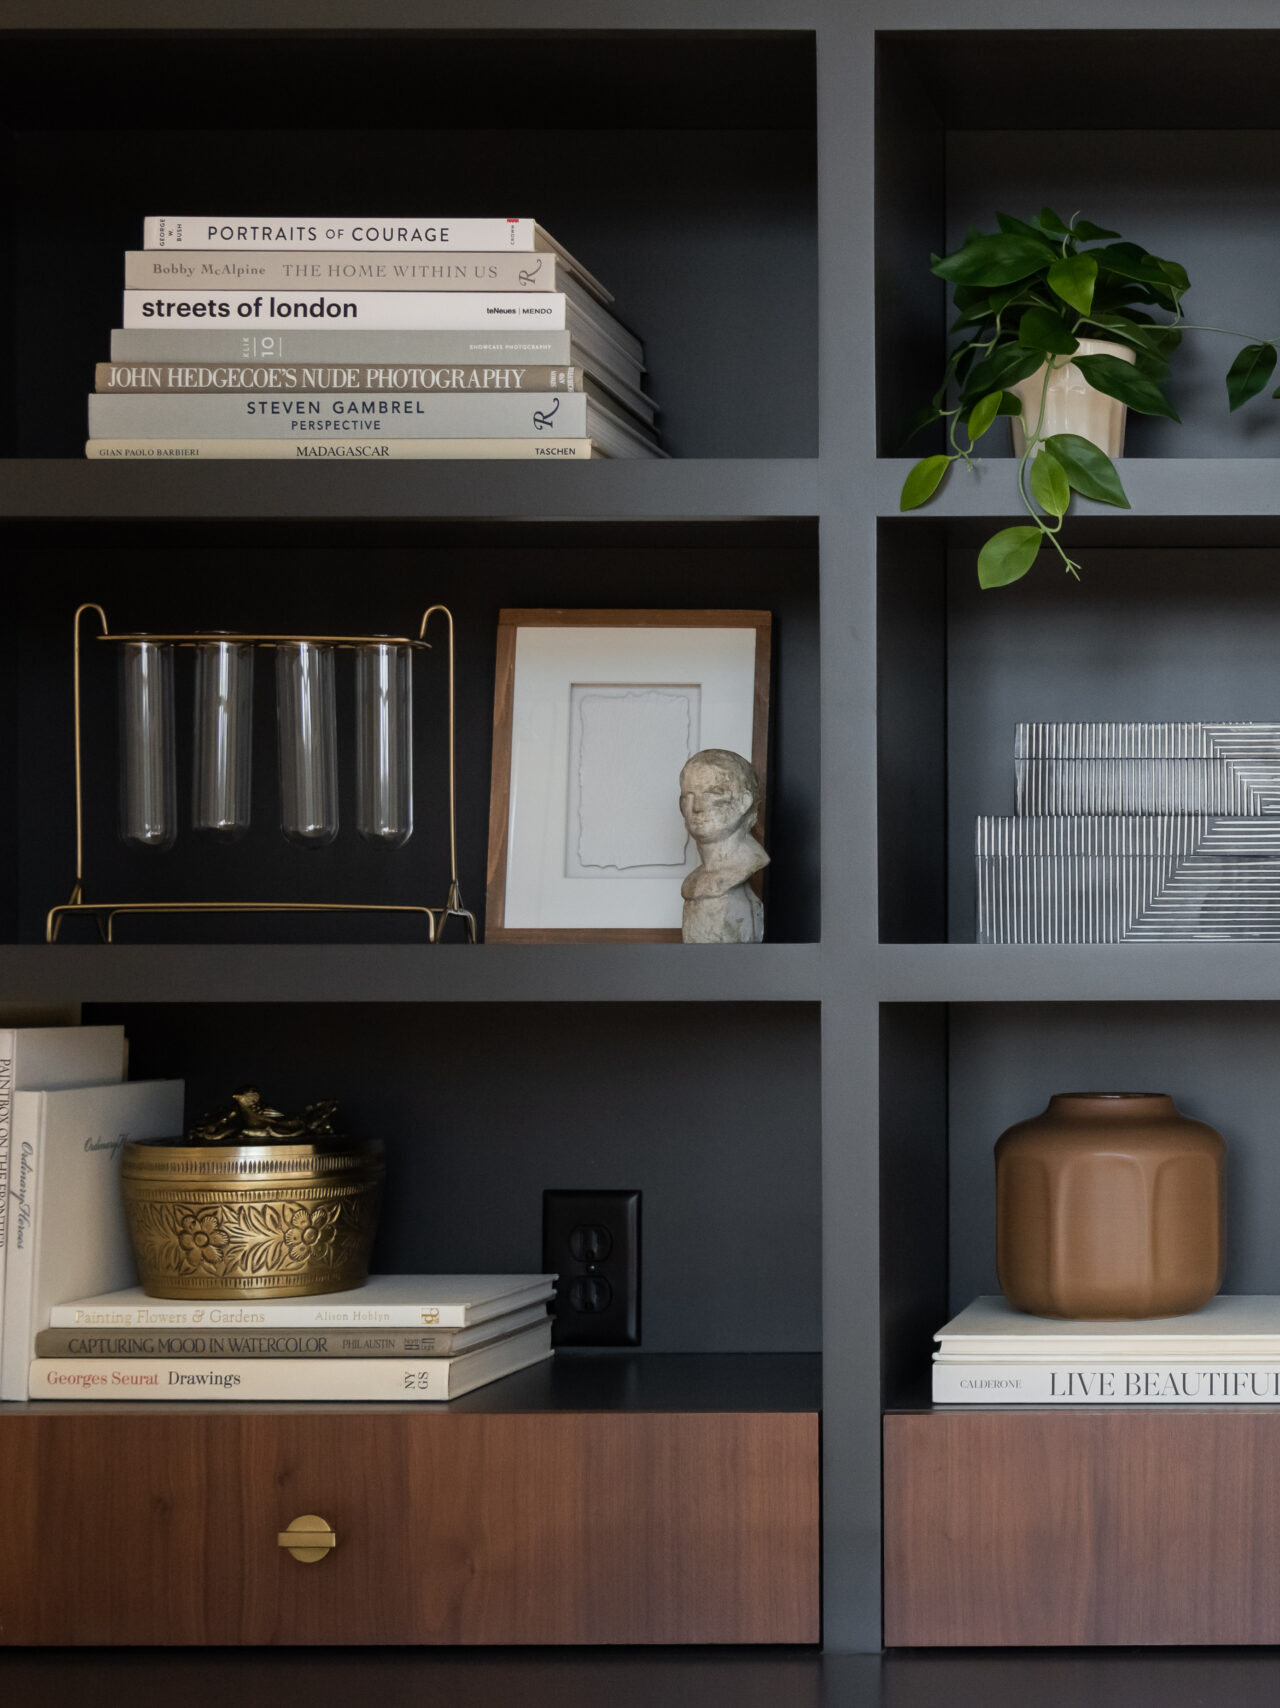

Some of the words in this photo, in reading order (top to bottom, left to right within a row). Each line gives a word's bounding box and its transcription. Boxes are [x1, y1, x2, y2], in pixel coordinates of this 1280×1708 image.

[208, 226, 317, 241] PORTRAITS
[326, 229, 344, 239] OF
[352, 228, 449, 241] COURAGE
[153, 264, 195, 277] Bobby
[201, 264, 266, 277] McAlpine
[283, 264, 321, 277] THE
[328, 265, 386, 278] HOME
[393, 266, 467, 278] WITHIN
[474, 266, 497, 278] US
[142, 300, 230, 317] streets
[237, 297, 263, 317] of
[270, 297, 358, 318] london
[261, 337, 274, 358] 10
[108, 367, 162, 388] JOHN
[168, 367, 297, 388] HEDGECOE'S
[302, 368, 360, 388] NUDE
[366, 368, 526, 388] PHOTOGRAPHY
[247, 401, 320, 414] STEVEN
[333, 401, 424, 414] GAMBREL
[292, 421, 381, 430] PERSPECTIVE
[296, 447, 390, 457] MADAGASCAR
[75, 1310, 132, 1326] Painting
[137, 1309, 187, 1323] Flowers
[192, 1309, 205, 1323] &
[209, 1309, 265, 1323] Gardens
[315, 1311, 349, 1321] Alison
[353, 1311, 390, 1322] Hoblyn
[68, 1338, 154, 1353] CAPTURING
[158, 1338, 206, 1353] MOOD
[210, 1338, 224, 1352] IN
[228, 1337, 328, 1352] WATERCOLOR
[342, 1339, 362, 1350] PHIL
[364, 1339, 396, 1349] AUSTIN
[47, 1372, 108, 1388] Georges
[112, 1372, 159, 1385] Seurat
[168, 1371, 241, 1388] Drawings
[960, 1380, 1022, 1389] CALDERONE
[1050, 1372, 1115, 1396] LIVE
